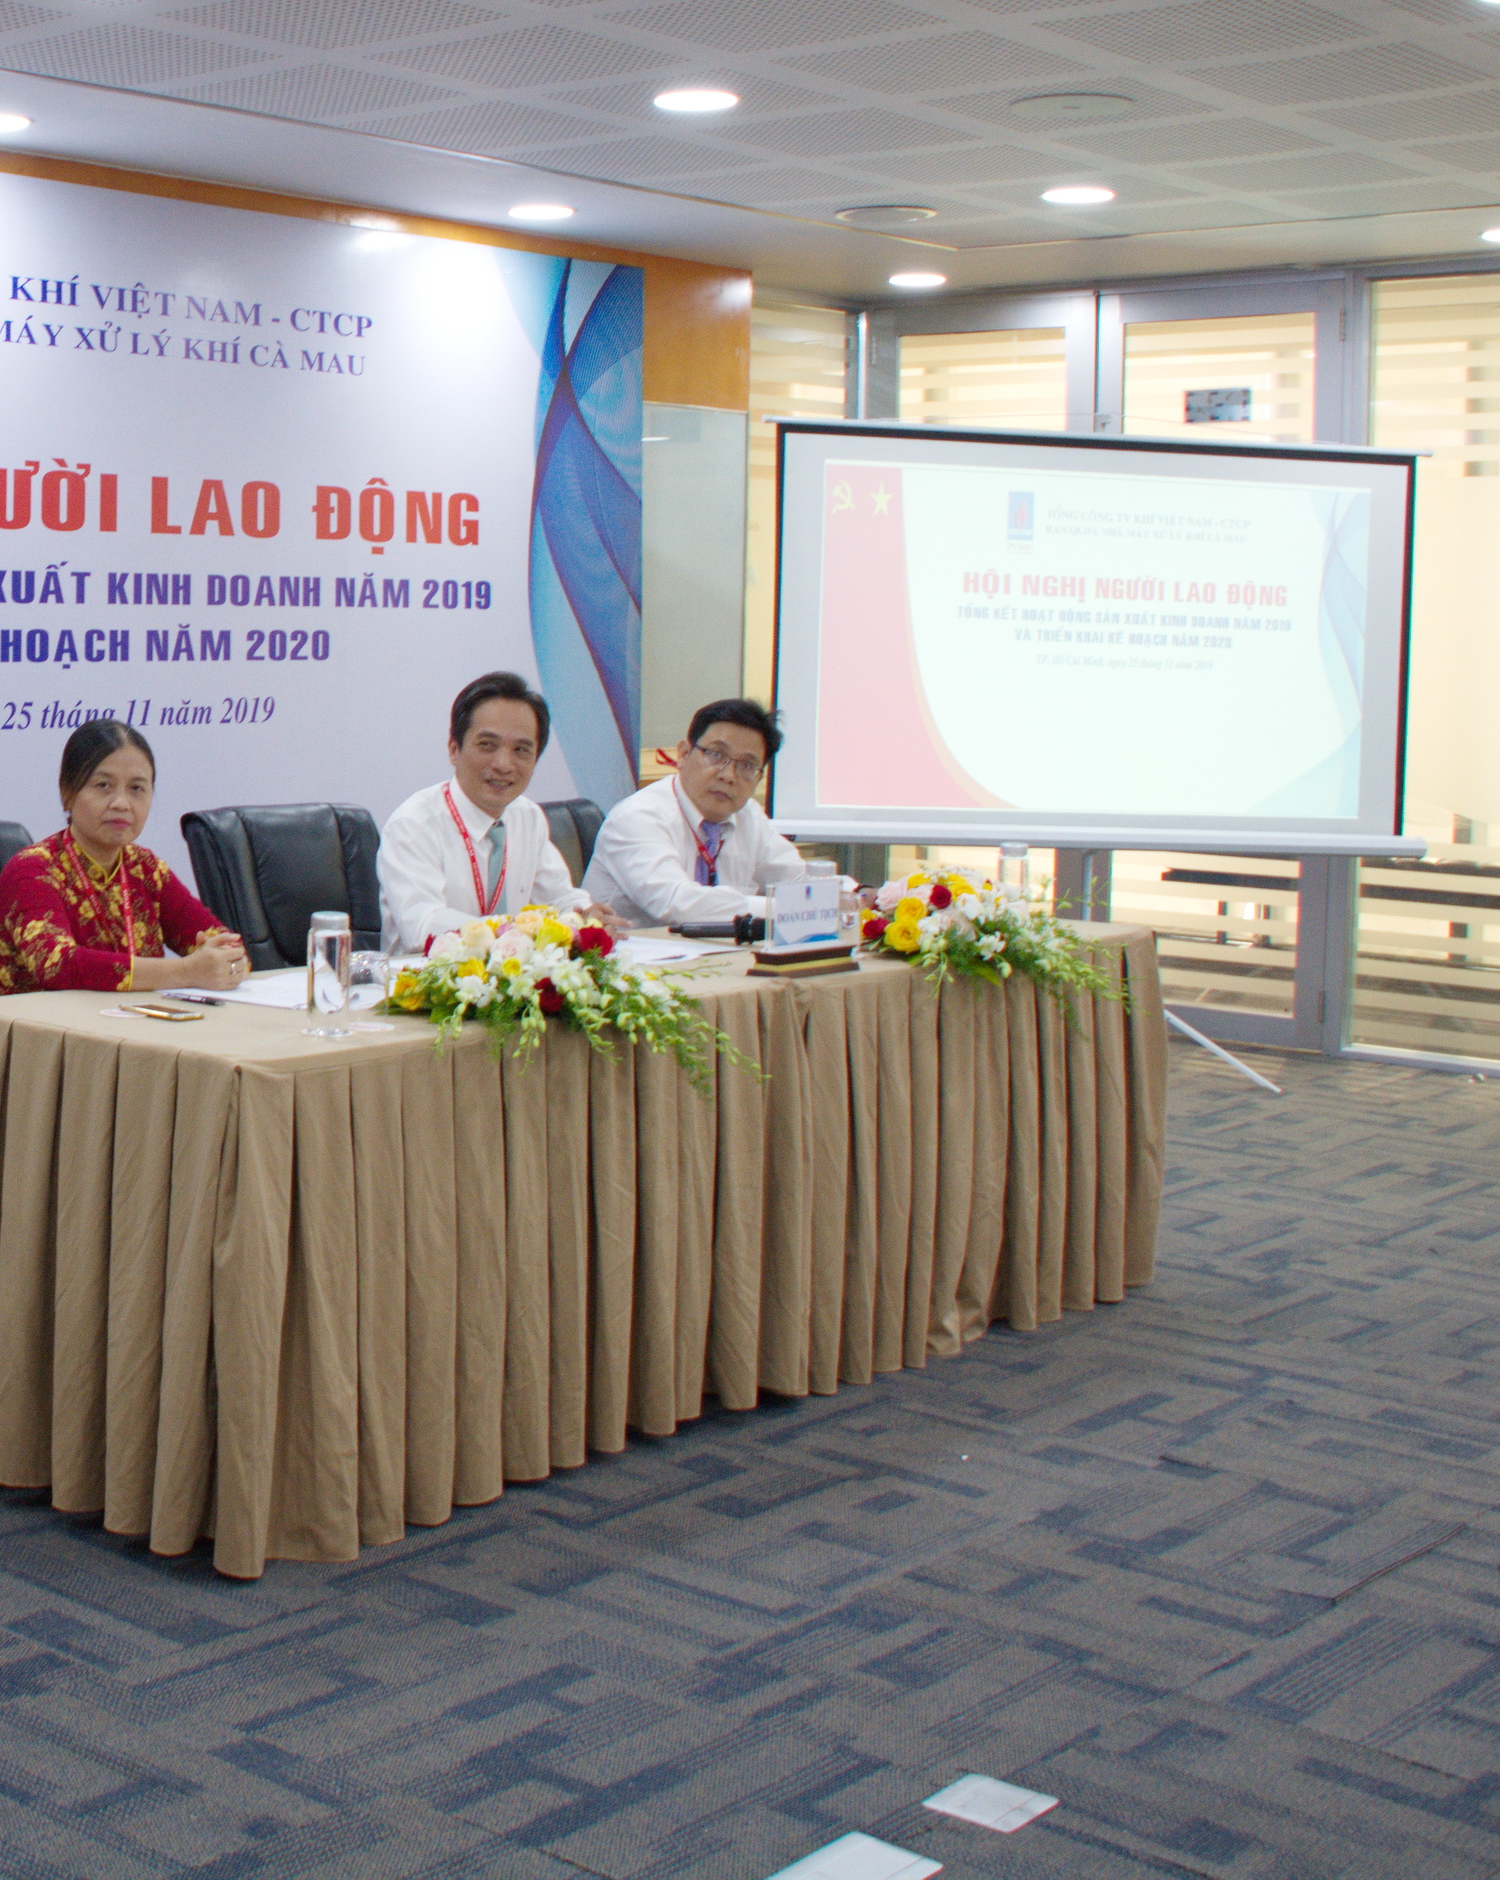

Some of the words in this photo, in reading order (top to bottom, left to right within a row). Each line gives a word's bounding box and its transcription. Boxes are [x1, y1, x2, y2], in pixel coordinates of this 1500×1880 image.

[10, 275, 80, 307] KHÍ
[91, 282, 176, 317] VIỆT
[185, 297, 261, 326] NAM
[290, 307, 373, 338] CTCP
[75, 322, 121, 353] XỬ
[130, 330, 171, 358] LÝ
[183, 337, 240, 364] KHÍ
[250, 344, 289, 368] CÀ
[300, 351, 365, 376] MAU
[151, 476, 280, 538] LAO
[312, 478, 479, 555] ĐỘNG
[108, 572, 191, 606] KINH
[207, 575, 320, 608] DOANH
[335, 572, 409, 609] NĂM
[422, 579, 491, 610] 2019
[963, 568, 1011, 599] HỘI
[1022, 574, 1086, 603] NGHỊ
[1094, 575, 1165, 601] NGƯỜI
[1173, 581, 1216, 604] LAO
[1227, 580, 1287, 610] ĐỘNG
[0, 628, 129, 669] HOẠCH
[145, 623, 231, 661] NĂM
[246, 630, 330, 661] 2020
[1, 701, 33, 730] 25
[126, 699, 152, 727] 11
[160, 700, 212, 726] năm
[220, 696, 275, 724] 2019
